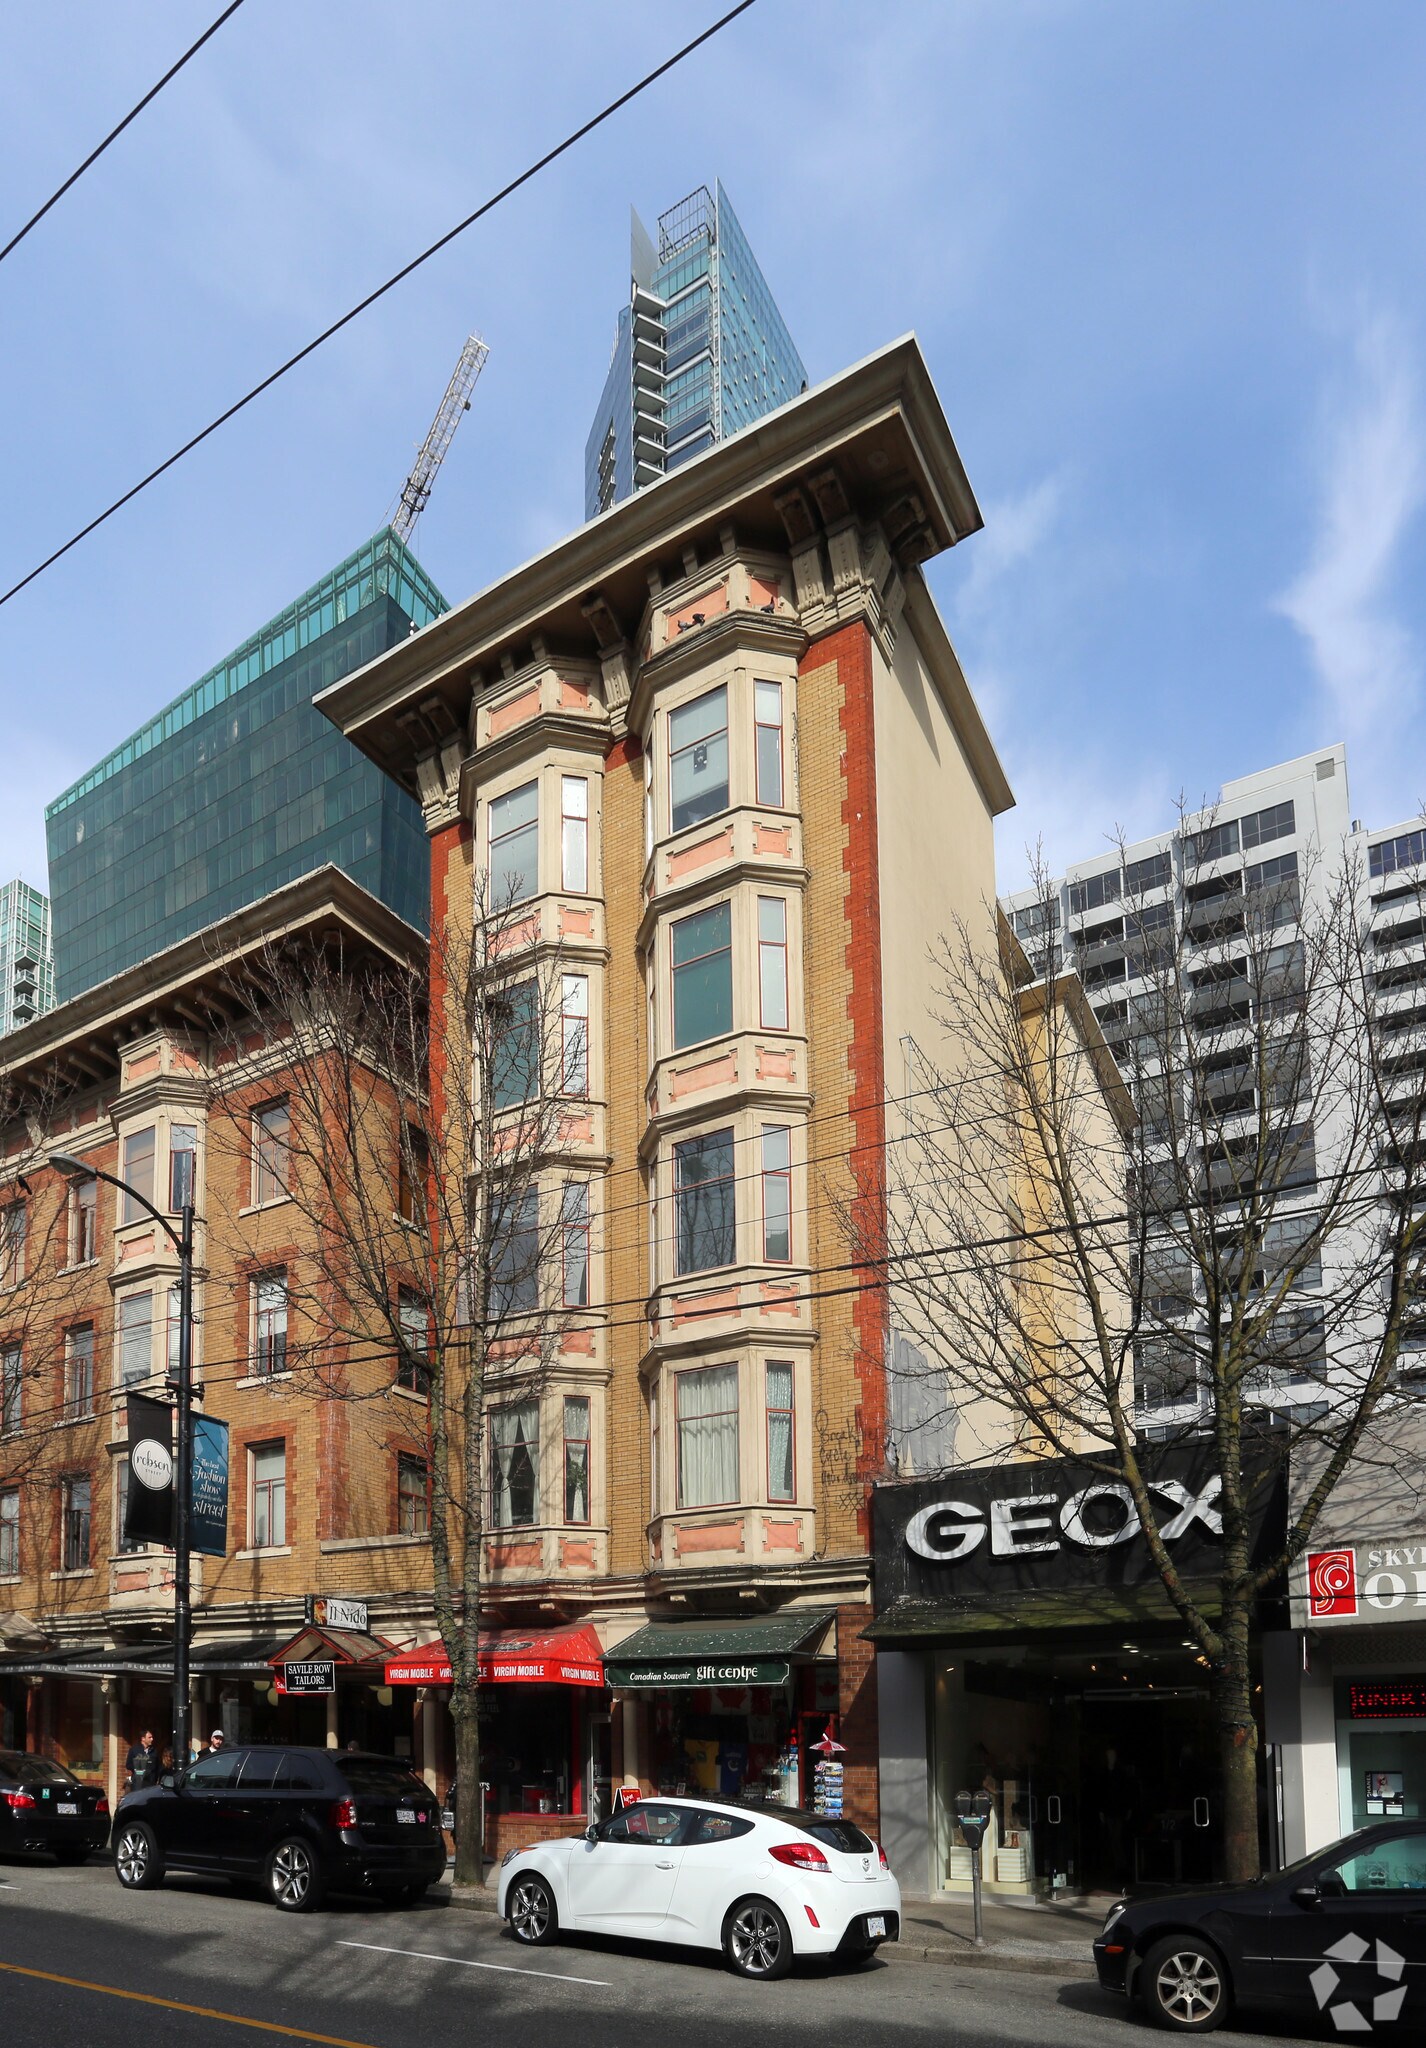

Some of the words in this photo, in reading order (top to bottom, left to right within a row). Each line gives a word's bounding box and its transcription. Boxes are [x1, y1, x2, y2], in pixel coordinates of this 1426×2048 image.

[136, 1450, 171, 1475] robson
[191, 1464, 226, 1484] Fashion
[200, 1480, 221, 1494] show
[193, 1500, 228, 1518] street
[905, 1474, 1224, 1560] GEOX
[340, 1607, 366, 1625] Nido
[288, 1665, 313, 1674] SAVILE
[314, 1664, 331, 1674] ROW
[389, 1669, 409, 1679] VIRGIN
[410, 1668, 434, 1679] MOBILE
[493, 1667, 516, 1677] VIRGIN
[517, 1665, 545, 1676] MOBILE
[560, 1667, 579, 1679] VIRGIN
[579, 1669, 600, 1681] MOBILE
[629, 1672, 662, 1681] Canadian
[663, 1671, 691, 1681] Souvenir
[696, 1665, 716, 1680] gift
[718, 1666, 758, 1681] centre
[294, 1675, 325, 1685] TAILORS
